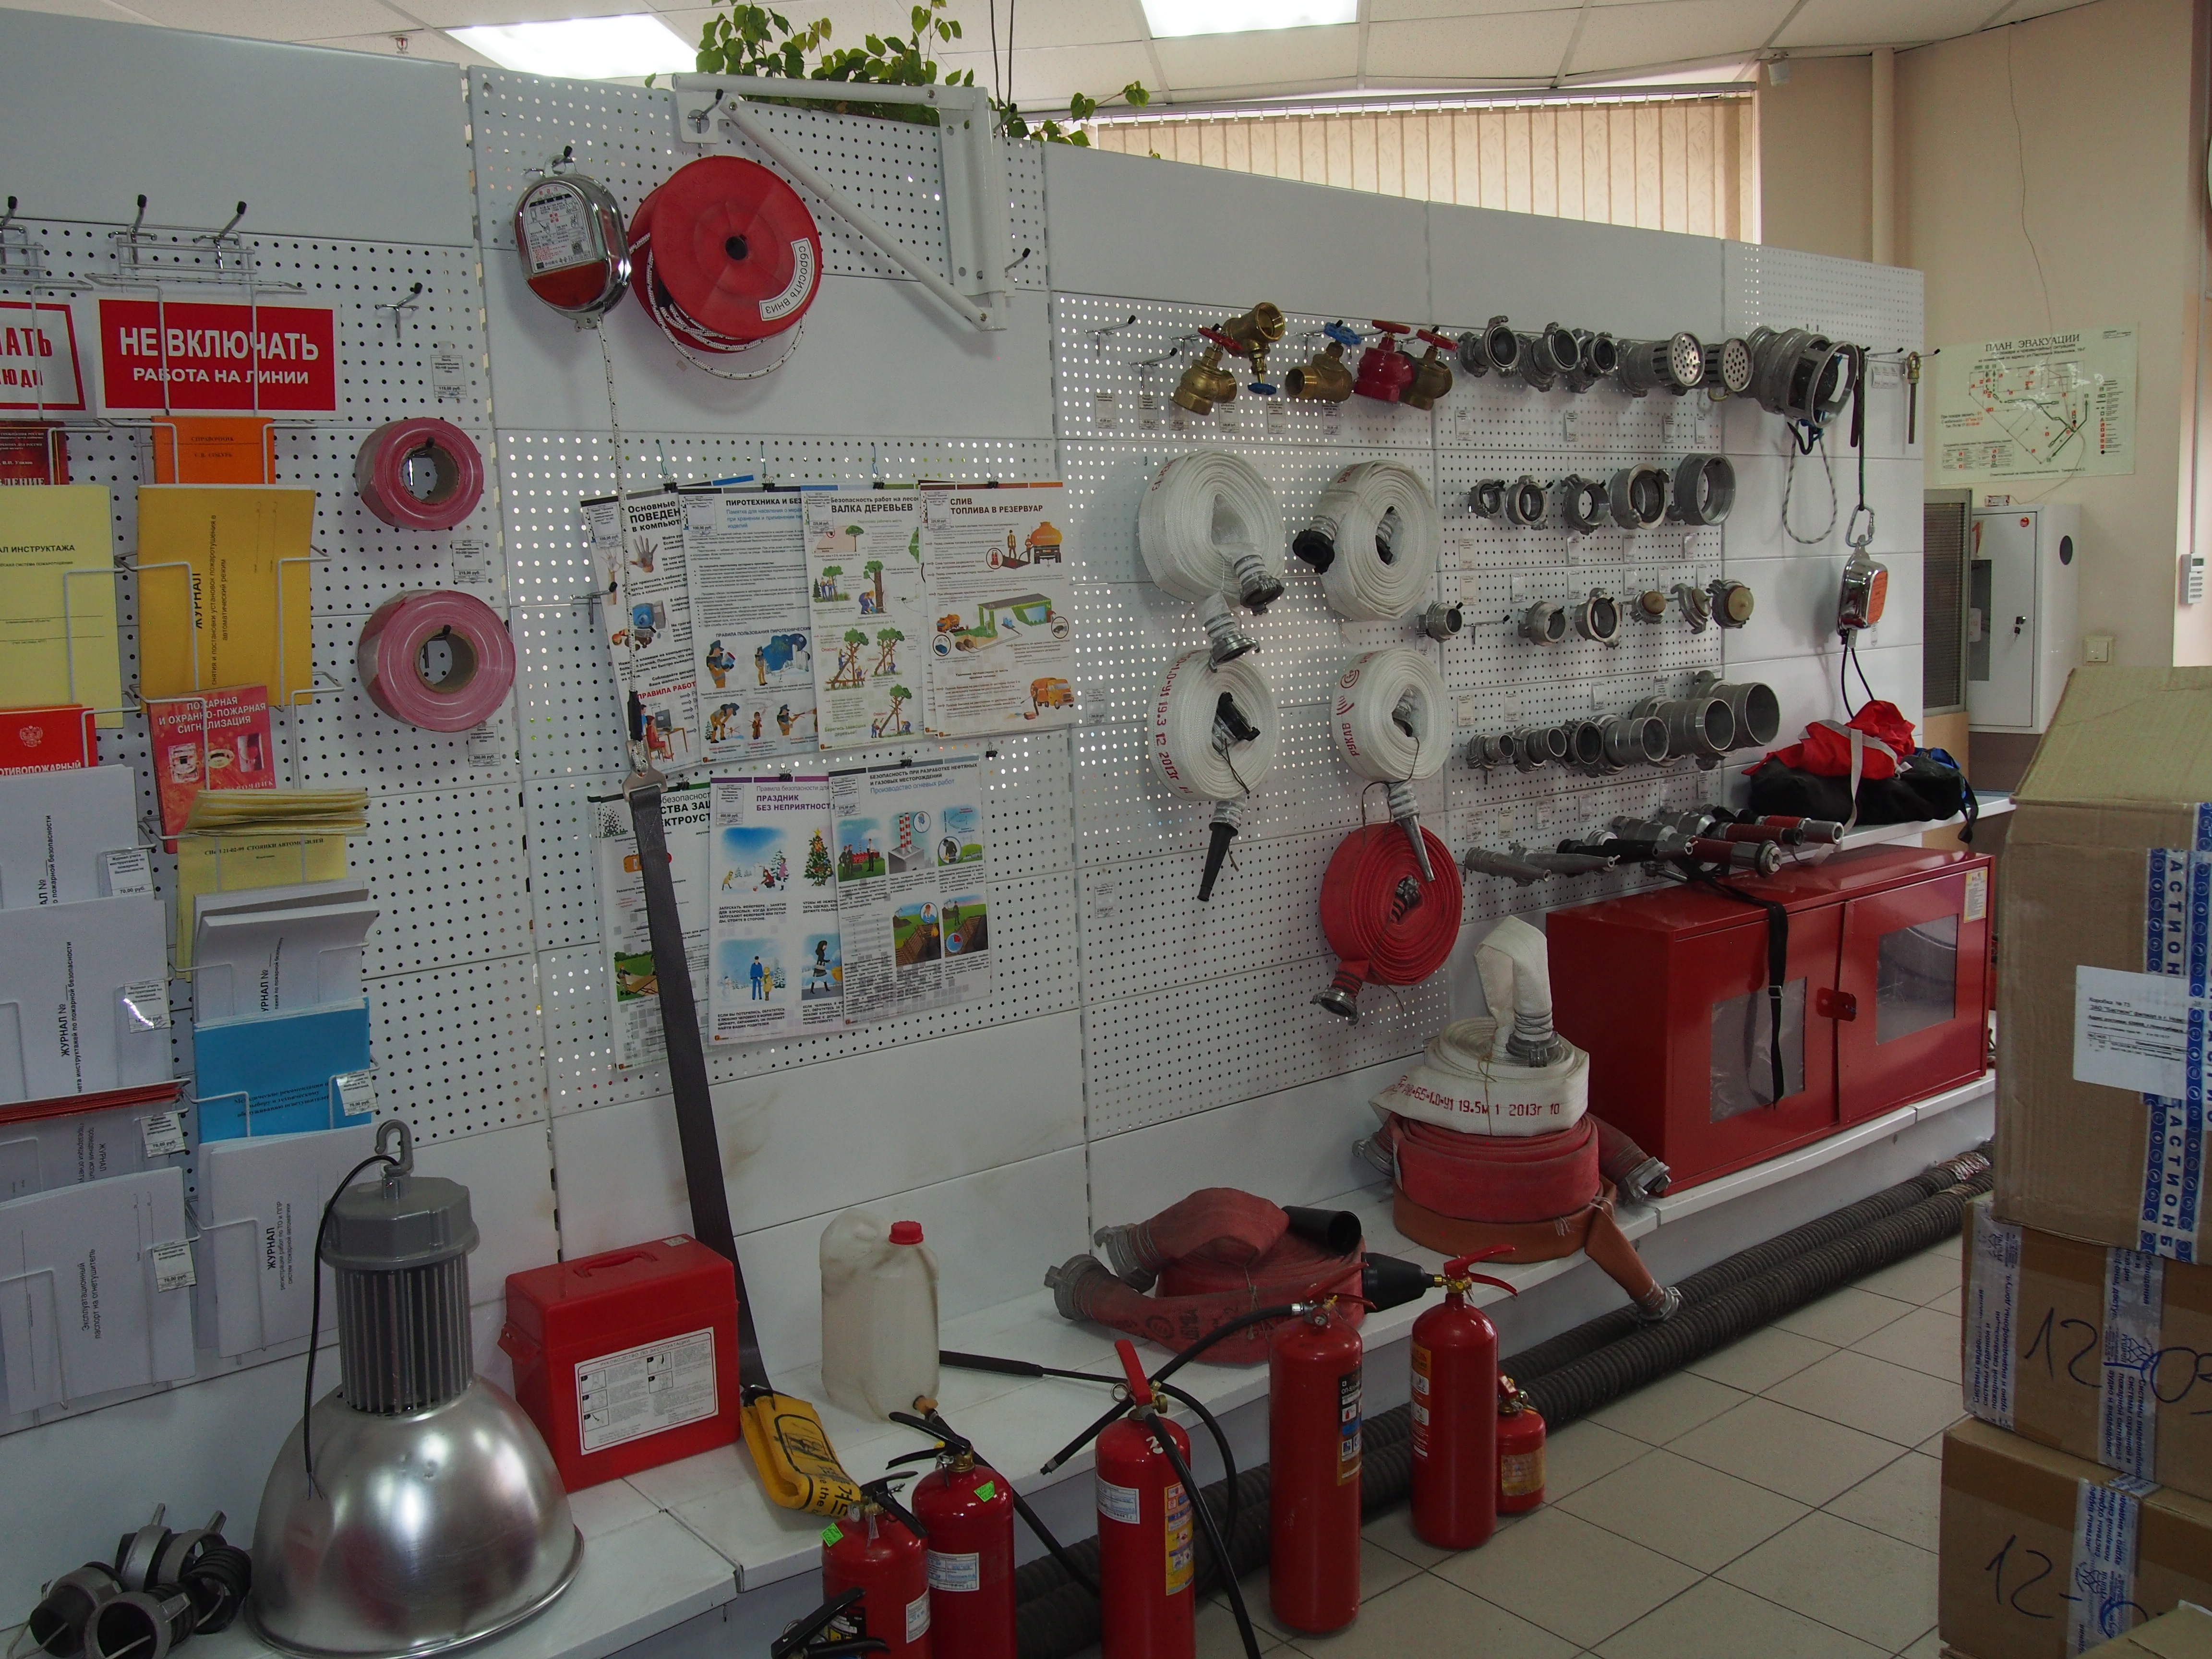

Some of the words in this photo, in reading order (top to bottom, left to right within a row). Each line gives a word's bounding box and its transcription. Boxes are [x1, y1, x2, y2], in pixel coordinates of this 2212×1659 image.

[790, 246, 809, 298] сбросить
[765, 298, 790, 313] вниз
[120, 327, 158, 356] НЕ
[167, 329, 319, 360] ВКЛЮЧАТЬ
[1985, 342, 2012, 352] ПЛАН
[2018, 334, 2080, 348] ЭВАКУАЦИИ
[133, 368, 210, 382] РАБОТА
[215, 370, 240, 383] НА
[246, 370, 308, 384] ЛИНИИ
[628, 501, 675, 513] Основные
[831, 505, 862, 513] ВАЛКА
[865, 504, 913, 513] ДЕРЕВЬЕВ
[637, 687, 672, 700] ПРАВИЛА
[673, 681, 696, 691] РАБОТ
[187, 697, 238, 711] ПОЖАРНАЯ
[178, 716, 251, 733] СИГНЛИЗАЦИЯ
[1342, 722, 1360, 756] РУКАВ
[899, 773, 942, 782] МЕСТОРОЖДЕНИЙ
[870, 785, 912, 794] Производство
[46, 815, 54, 862] безопасности
[48, 864, 58, 898] пожарной
[67, 941, 75, 989] безопасности
[58, 1004, 66, 1014] №
[68, 989, 78, 1022] пожарной
[58, 1016, 70, 1057] ЖУРНАЛ
[72, 1023, 78, 1032] по
[72, 1033, 82, 1079] инструктажей
[1509, 1104, 1542, 1116] 2013г
[277, 1220, 283, 1229] ТО
[266, 1227, 276, 1270] ЖУРНАЛ
[89, 1249, 99, 1298] огнетушитель
[78, 1262, 90, 1331] Эксплуатационный
[93, 1300, 99, 1309] на
[93, 1310, 101, 1339] паспорт
[1972, 1367, 1981, 1403] Системы
[817, 1487, 829, 1506] the
[2104, 1518, 2114, 1562] пожарной
